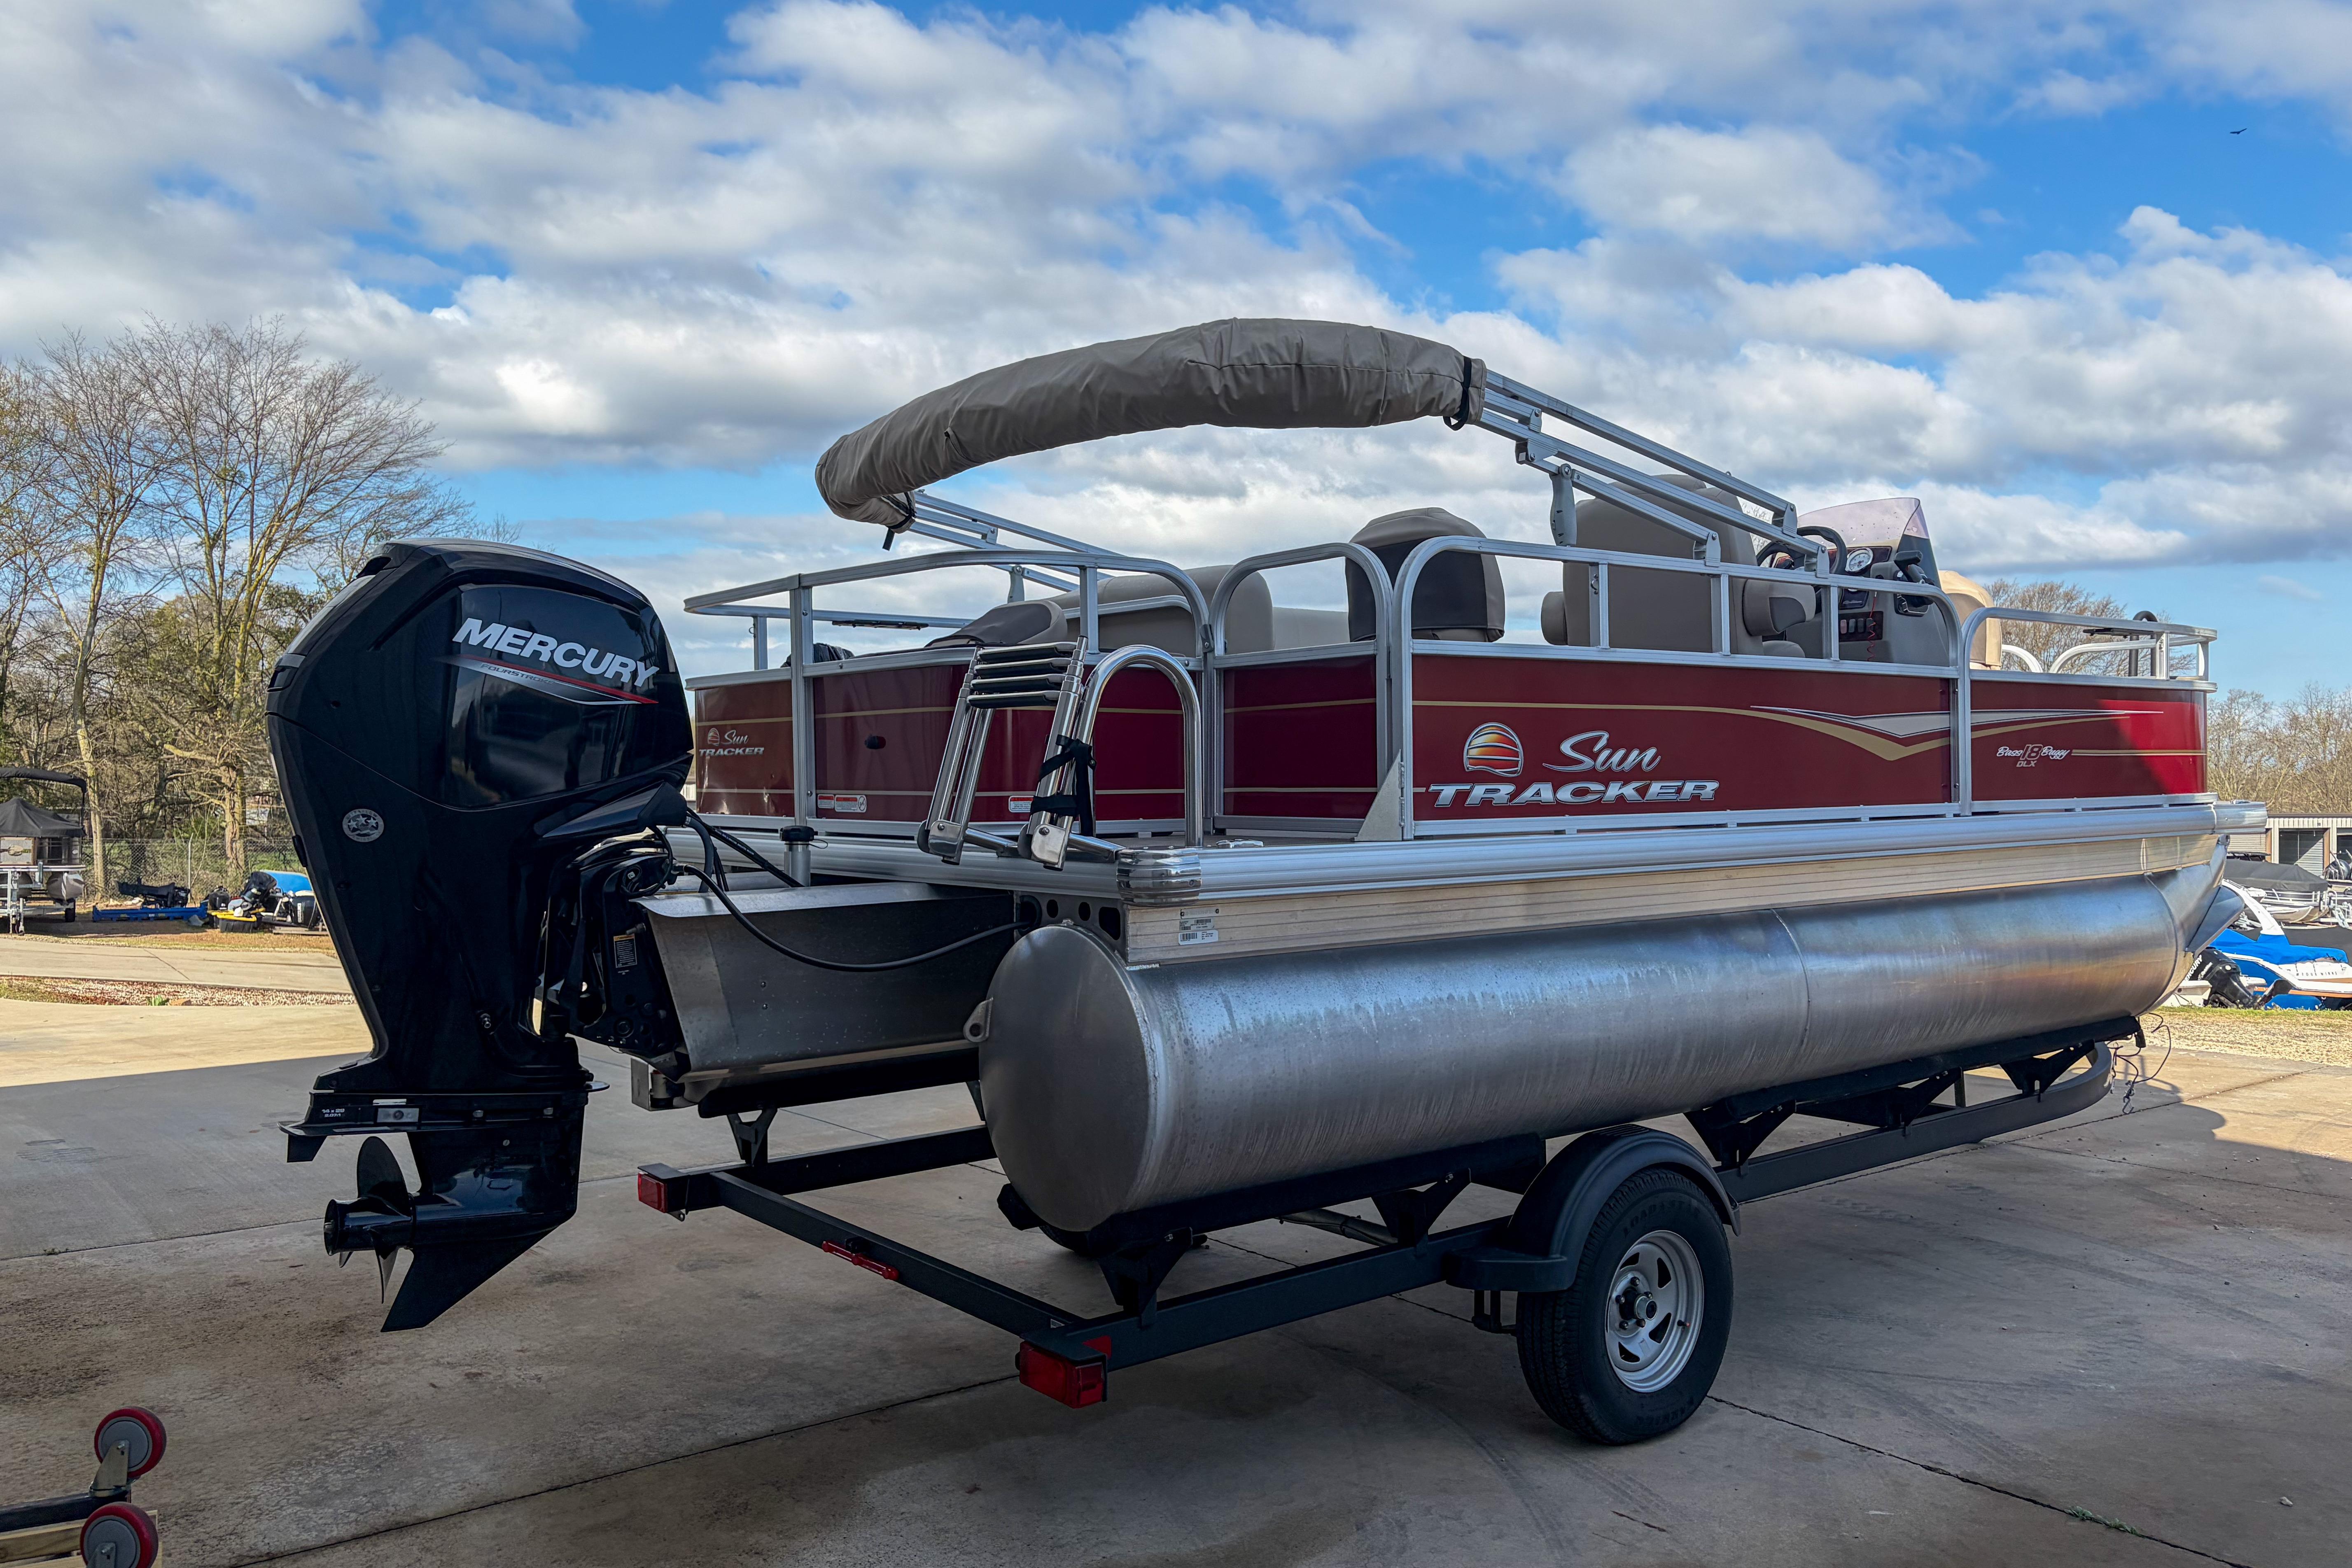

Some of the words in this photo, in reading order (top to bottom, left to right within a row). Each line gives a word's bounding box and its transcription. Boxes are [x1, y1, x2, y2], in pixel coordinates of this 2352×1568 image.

[452, 617, 660, 687] MERCURY
[721, 730, 749, 744] Sun
[699, 747, 765, 757] TRACKER
[1542, 730, 1661, 772] Sun
[1997, 746, 2023, 757] Bass
[2020, 744, 2043, 761] 18
[2041, 746, 2070, 760] Buggy
[1428, 780, 1720, 807] TRACKER
